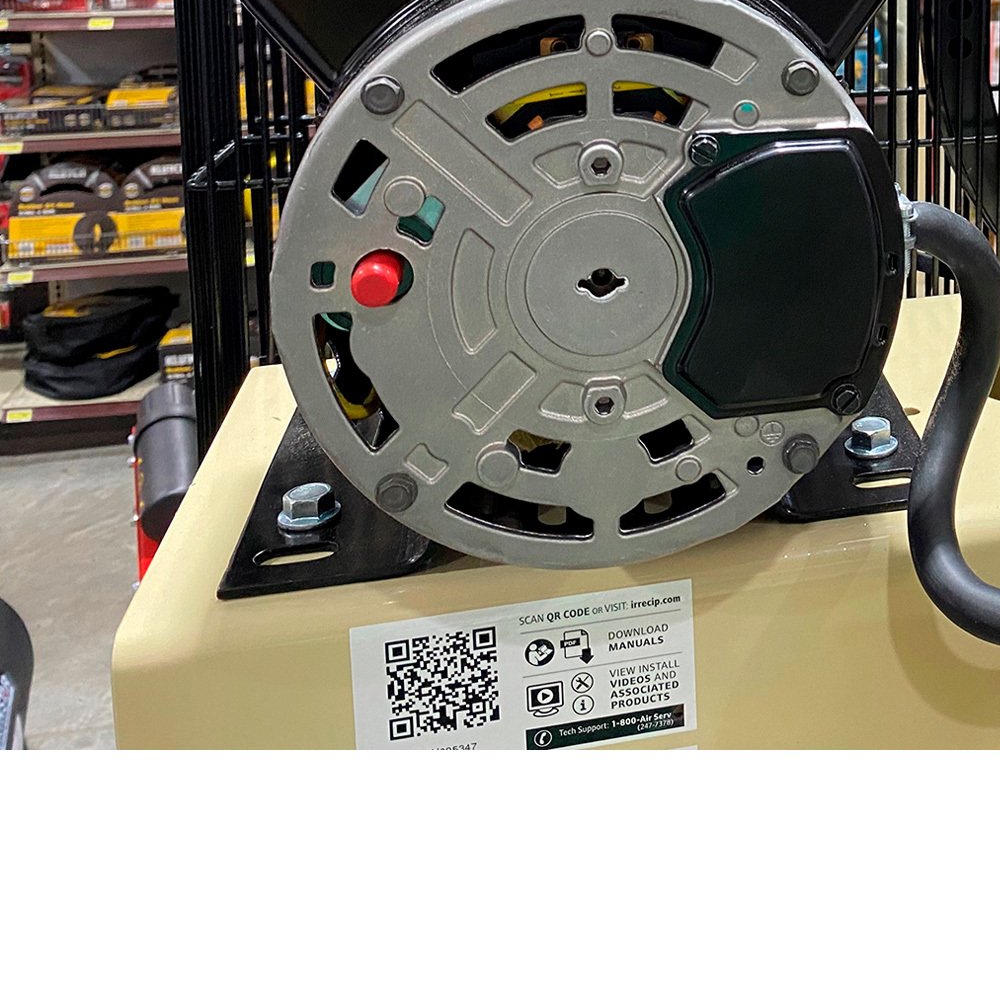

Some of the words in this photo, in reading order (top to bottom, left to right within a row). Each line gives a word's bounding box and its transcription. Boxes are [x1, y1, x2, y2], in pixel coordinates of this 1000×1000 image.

[519, 614, 545, 626] SCAN
[546, 612, 561, 623] QR
[563, 607, 590, 618] CODE
[592, 606, 603, 614] OR
[604, 601, 629, 613] VISIT:
[630, 595, 681, 609] irrecip.com
[608, 623, 669, 640] DOWNLOAD
[608, 636, 664, 652] MANUALS
[609, 666, 635, 678] VIEW
[638, 659, 680, 674] INSTALL
[609, 674, 650, 688] VIDEOS
[654, 670, 677, 682] AND
[610, 680, 680, 699] ASSOCIATED
[611, 692, 670, 709] PRODUCTS
[559, 728, 577, 737] Tech
[578, 721, 609, 734] Support:
[611, 715, 652, 728] 1-800-Air
[653, 711, 672, 721] Serv
[637, 719, 674, 732] (247-7378)
